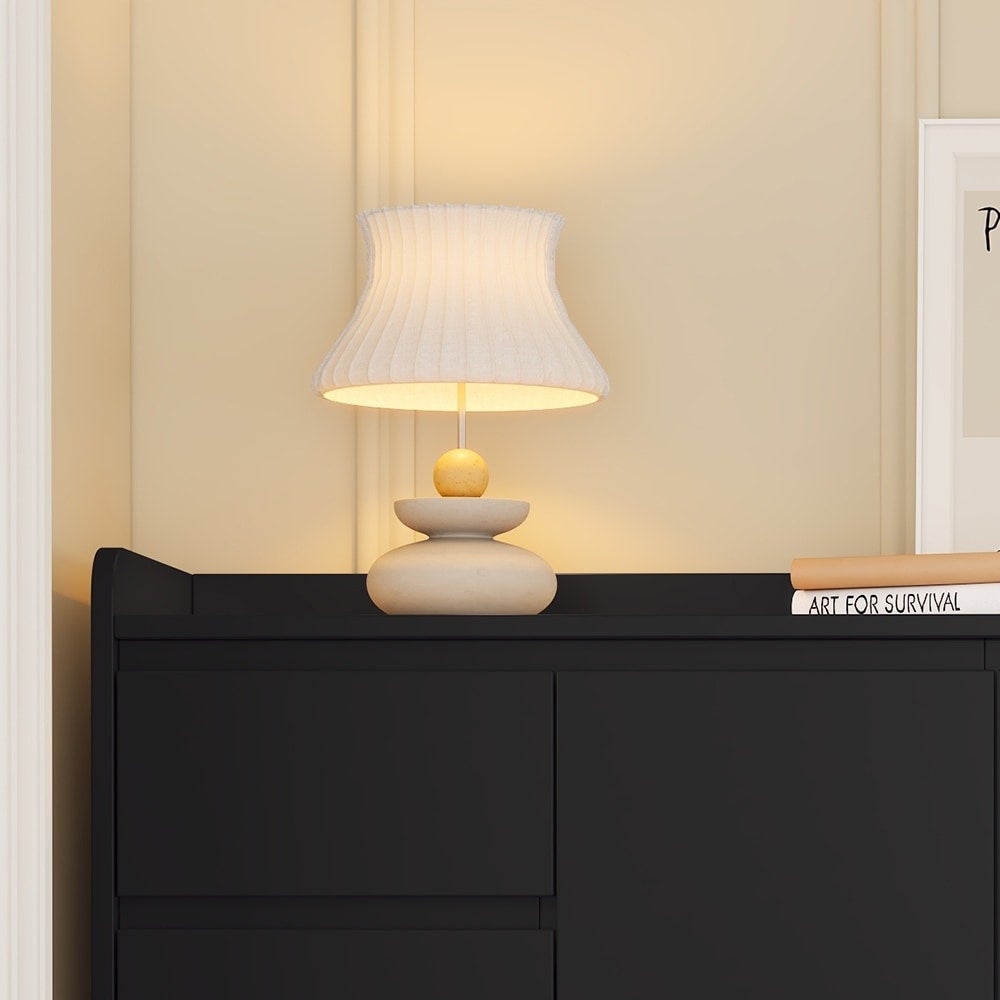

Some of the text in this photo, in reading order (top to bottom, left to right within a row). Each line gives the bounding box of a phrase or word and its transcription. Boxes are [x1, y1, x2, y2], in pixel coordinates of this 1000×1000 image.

[808, 592, 961, 614] ART FOR SURVIVAL
